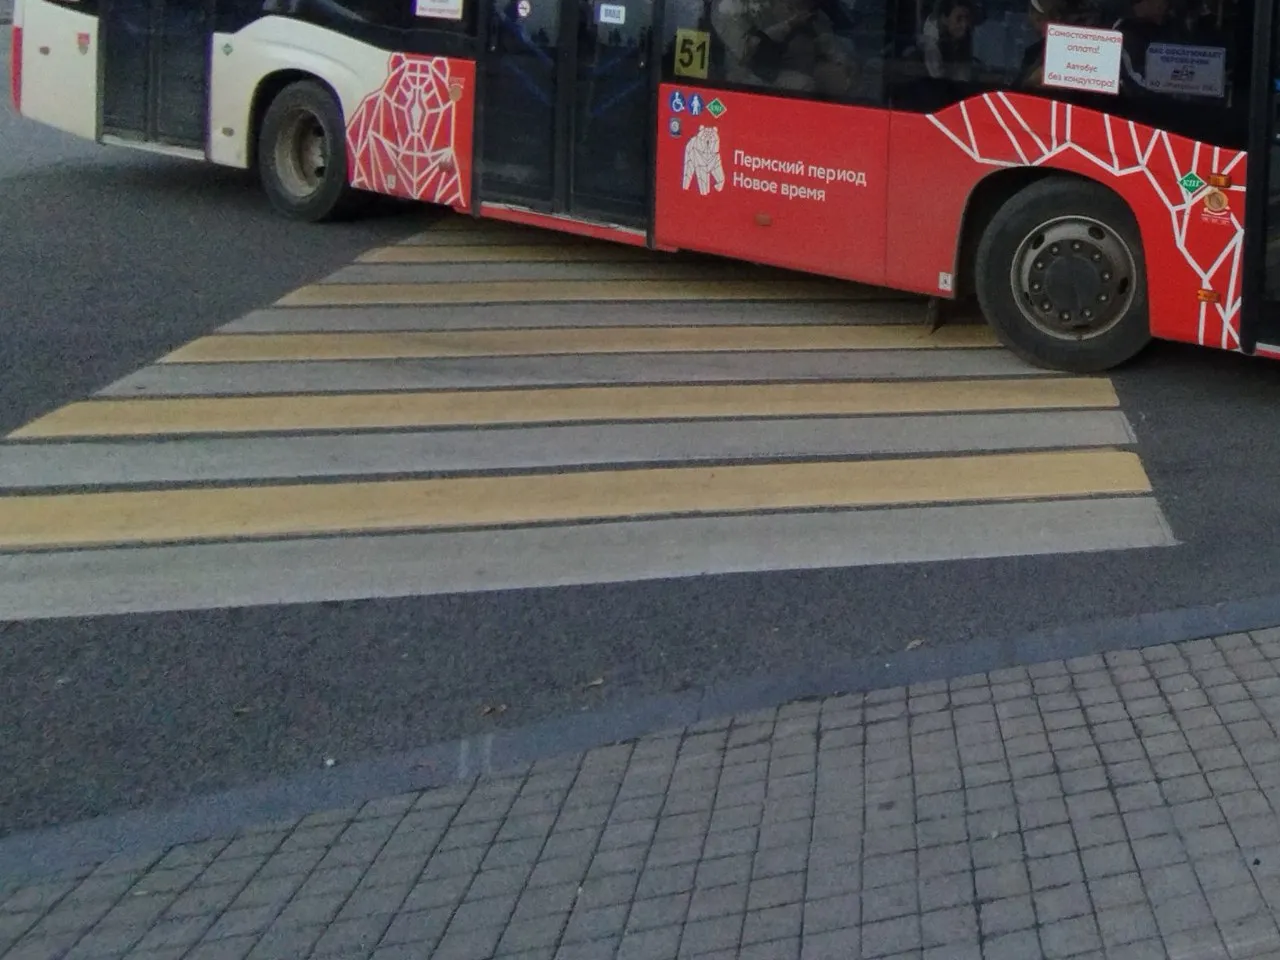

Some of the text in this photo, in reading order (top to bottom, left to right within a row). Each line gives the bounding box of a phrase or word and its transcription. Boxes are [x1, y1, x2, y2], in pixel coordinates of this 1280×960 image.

[679, 38, 706, 70] 51
[1067, 44, 1100, 54] оплата!
[1047, 72, 1061, 81] без
[1066, 62, 1098, 73] Автобус
[734, 150, 867, 187] Пермский период
[733, 173, 826, 202] Новое время
